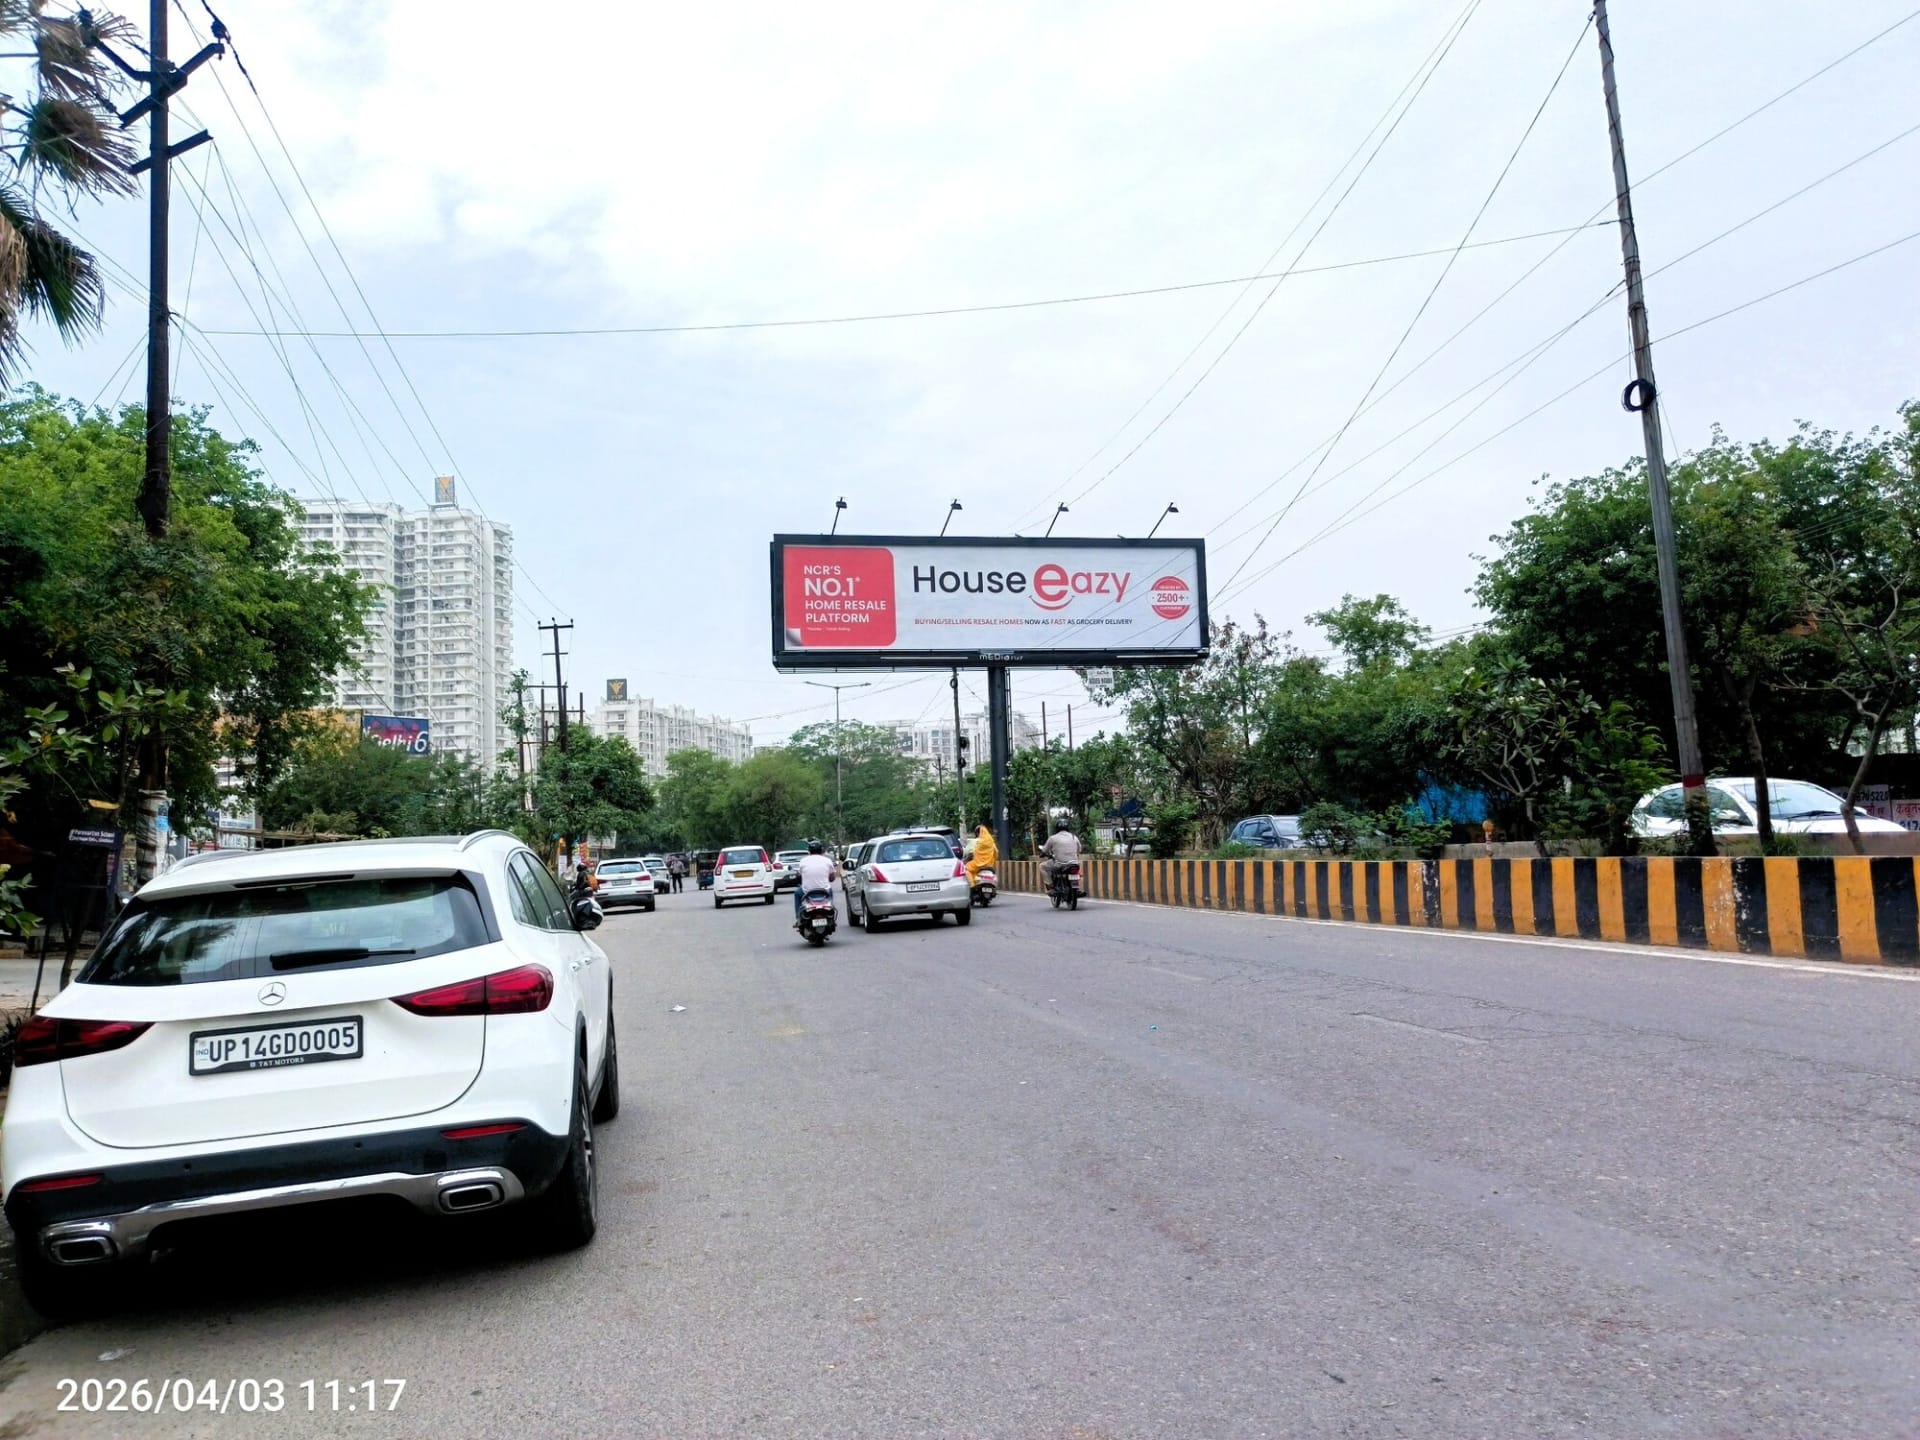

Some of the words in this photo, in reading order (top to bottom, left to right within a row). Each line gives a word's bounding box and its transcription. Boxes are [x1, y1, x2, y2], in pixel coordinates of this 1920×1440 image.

[803, 565, 841, 575] NCR'S
[805, 600, 841, 610] HOME
[844, 600, 887, 610] RESALE
[806, 613, 870, 623] PLATFORM
[275, 1056, 305, 1067] MOTORS
